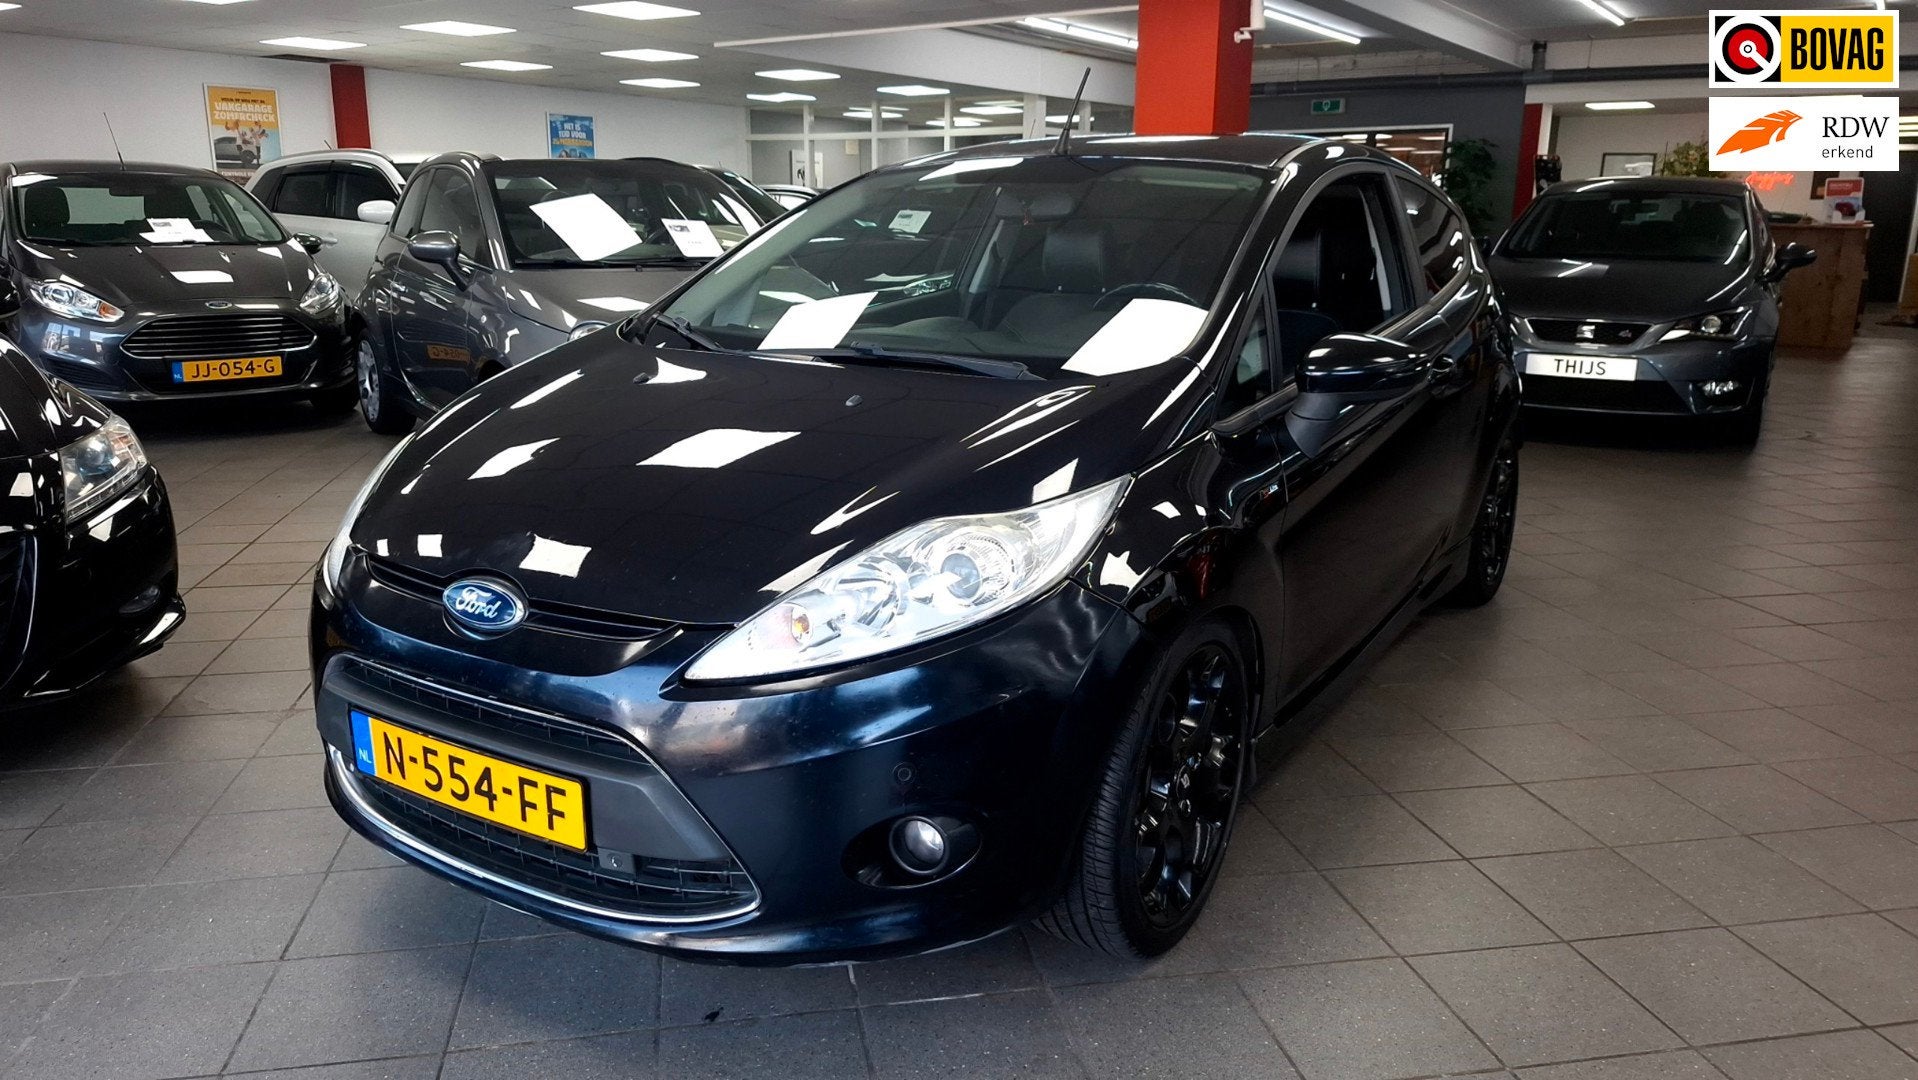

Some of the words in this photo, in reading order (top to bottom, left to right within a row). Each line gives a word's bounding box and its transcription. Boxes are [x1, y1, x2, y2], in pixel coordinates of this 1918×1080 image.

[213, 110, 275, 122] ZOMERCHECK
[214, 101, 273, 114] VAKGARAGE
[192, 359, 275, 379] JJ-054-G
[1554, 359, 1607, 376] THIJS
[455, 586, 502, 619] Ford
[358, 748, 372, 764] NL
[383, 731, 567, 831] N-554-FF
